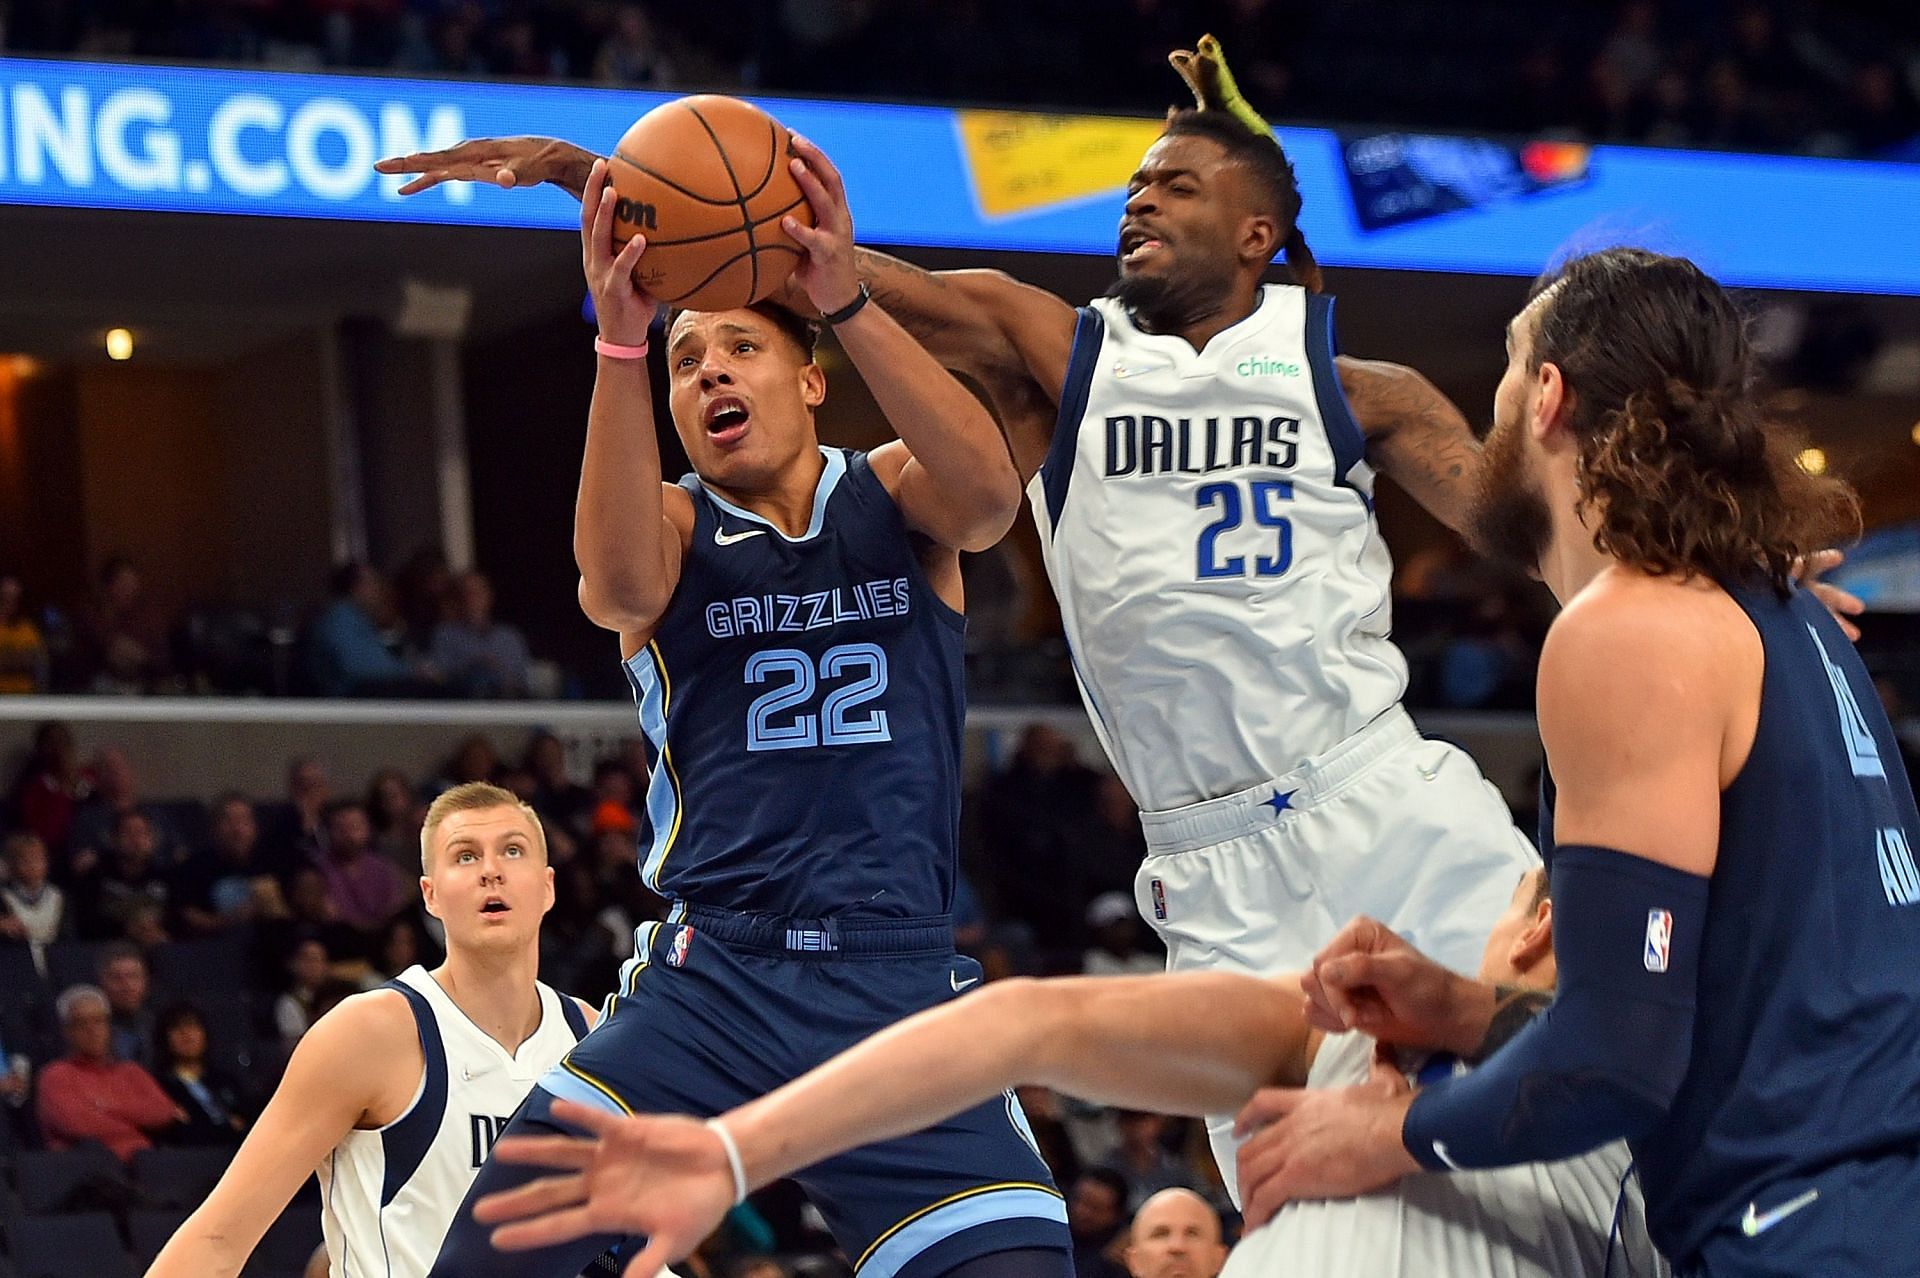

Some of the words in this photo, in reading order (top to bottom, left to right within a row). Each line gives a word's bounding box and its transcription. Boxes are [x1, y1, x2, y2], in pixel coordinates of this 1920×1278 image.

[0, 82, 475, 205] NG.COM
[1236, 356, 1300, 377] chime
[1104, 415, 1300, 478] DALLAS
[1195, 480, 1294, 581] 25
[705, 577, 910, 639] GRIZZLIES
[744, 642, 892, 752] 22
